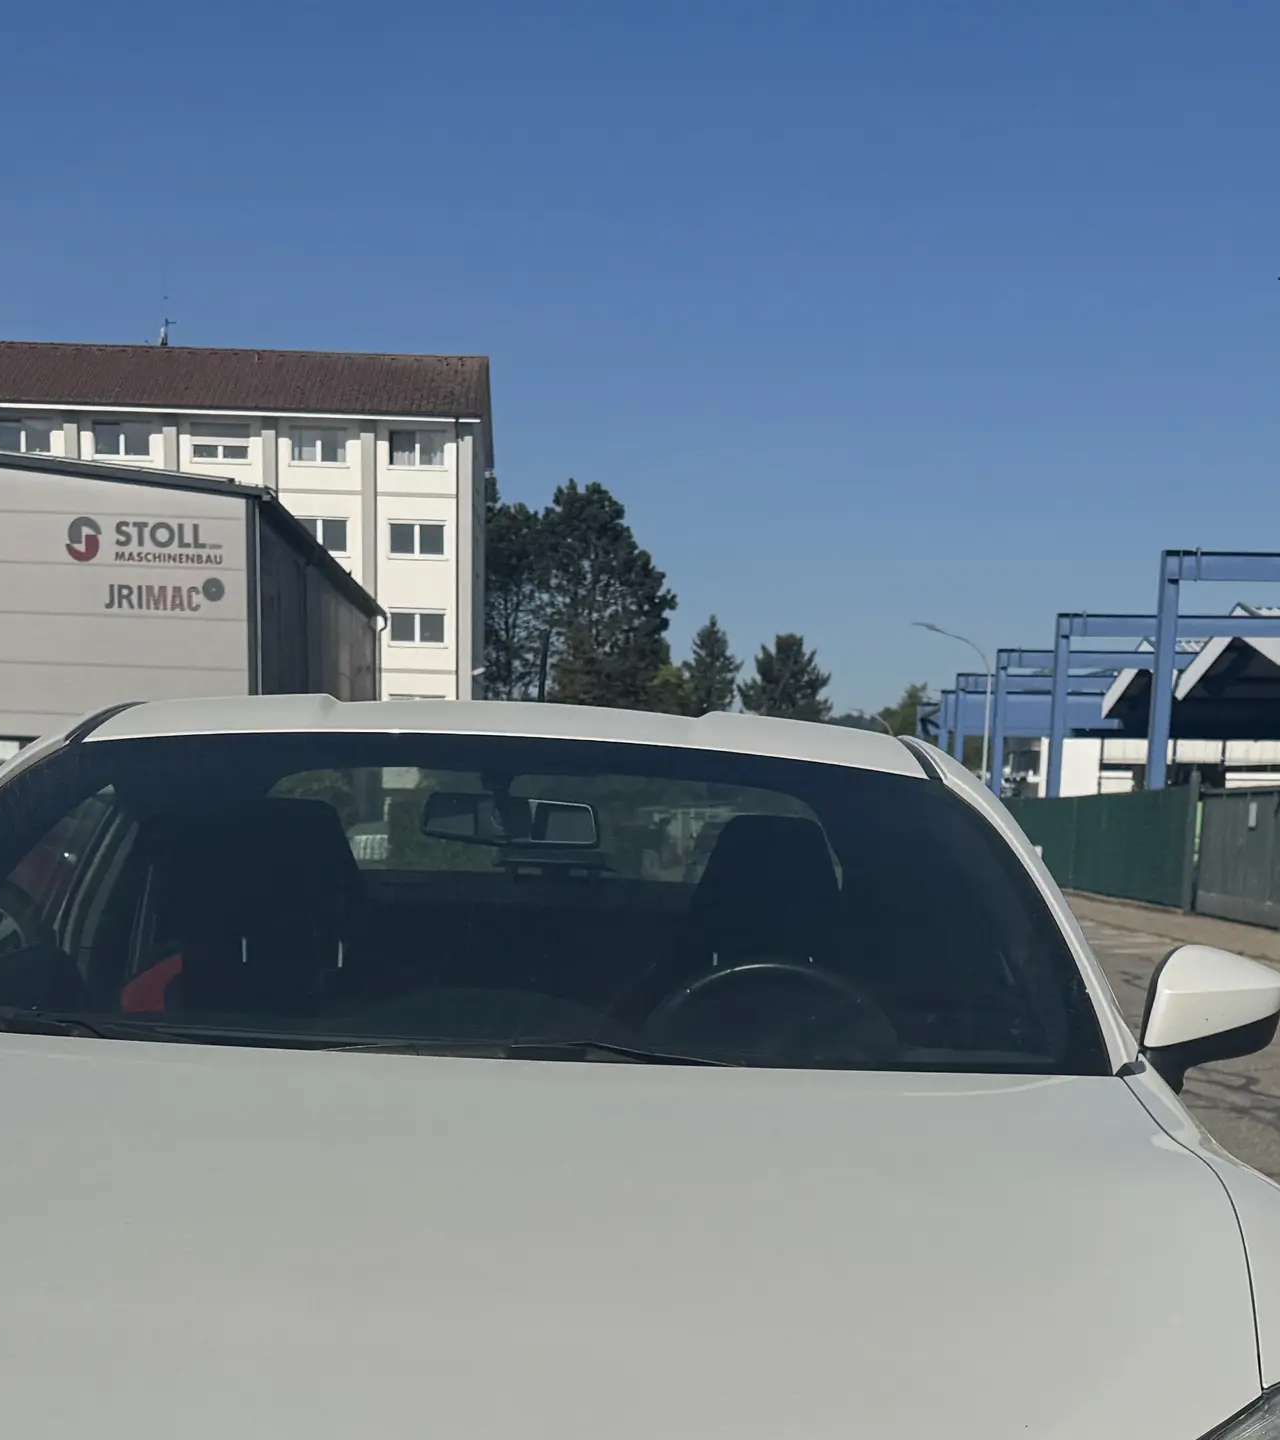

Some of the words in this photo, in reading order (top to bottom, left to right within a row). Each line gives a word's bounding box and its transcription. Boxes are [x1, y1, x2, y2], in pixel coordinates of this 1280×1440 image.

[115, 520, 207, 549] STOLL
[114, 551, 224, 565] MASCHINENBAU
[104, 583, 201, 612] JRIMAC
